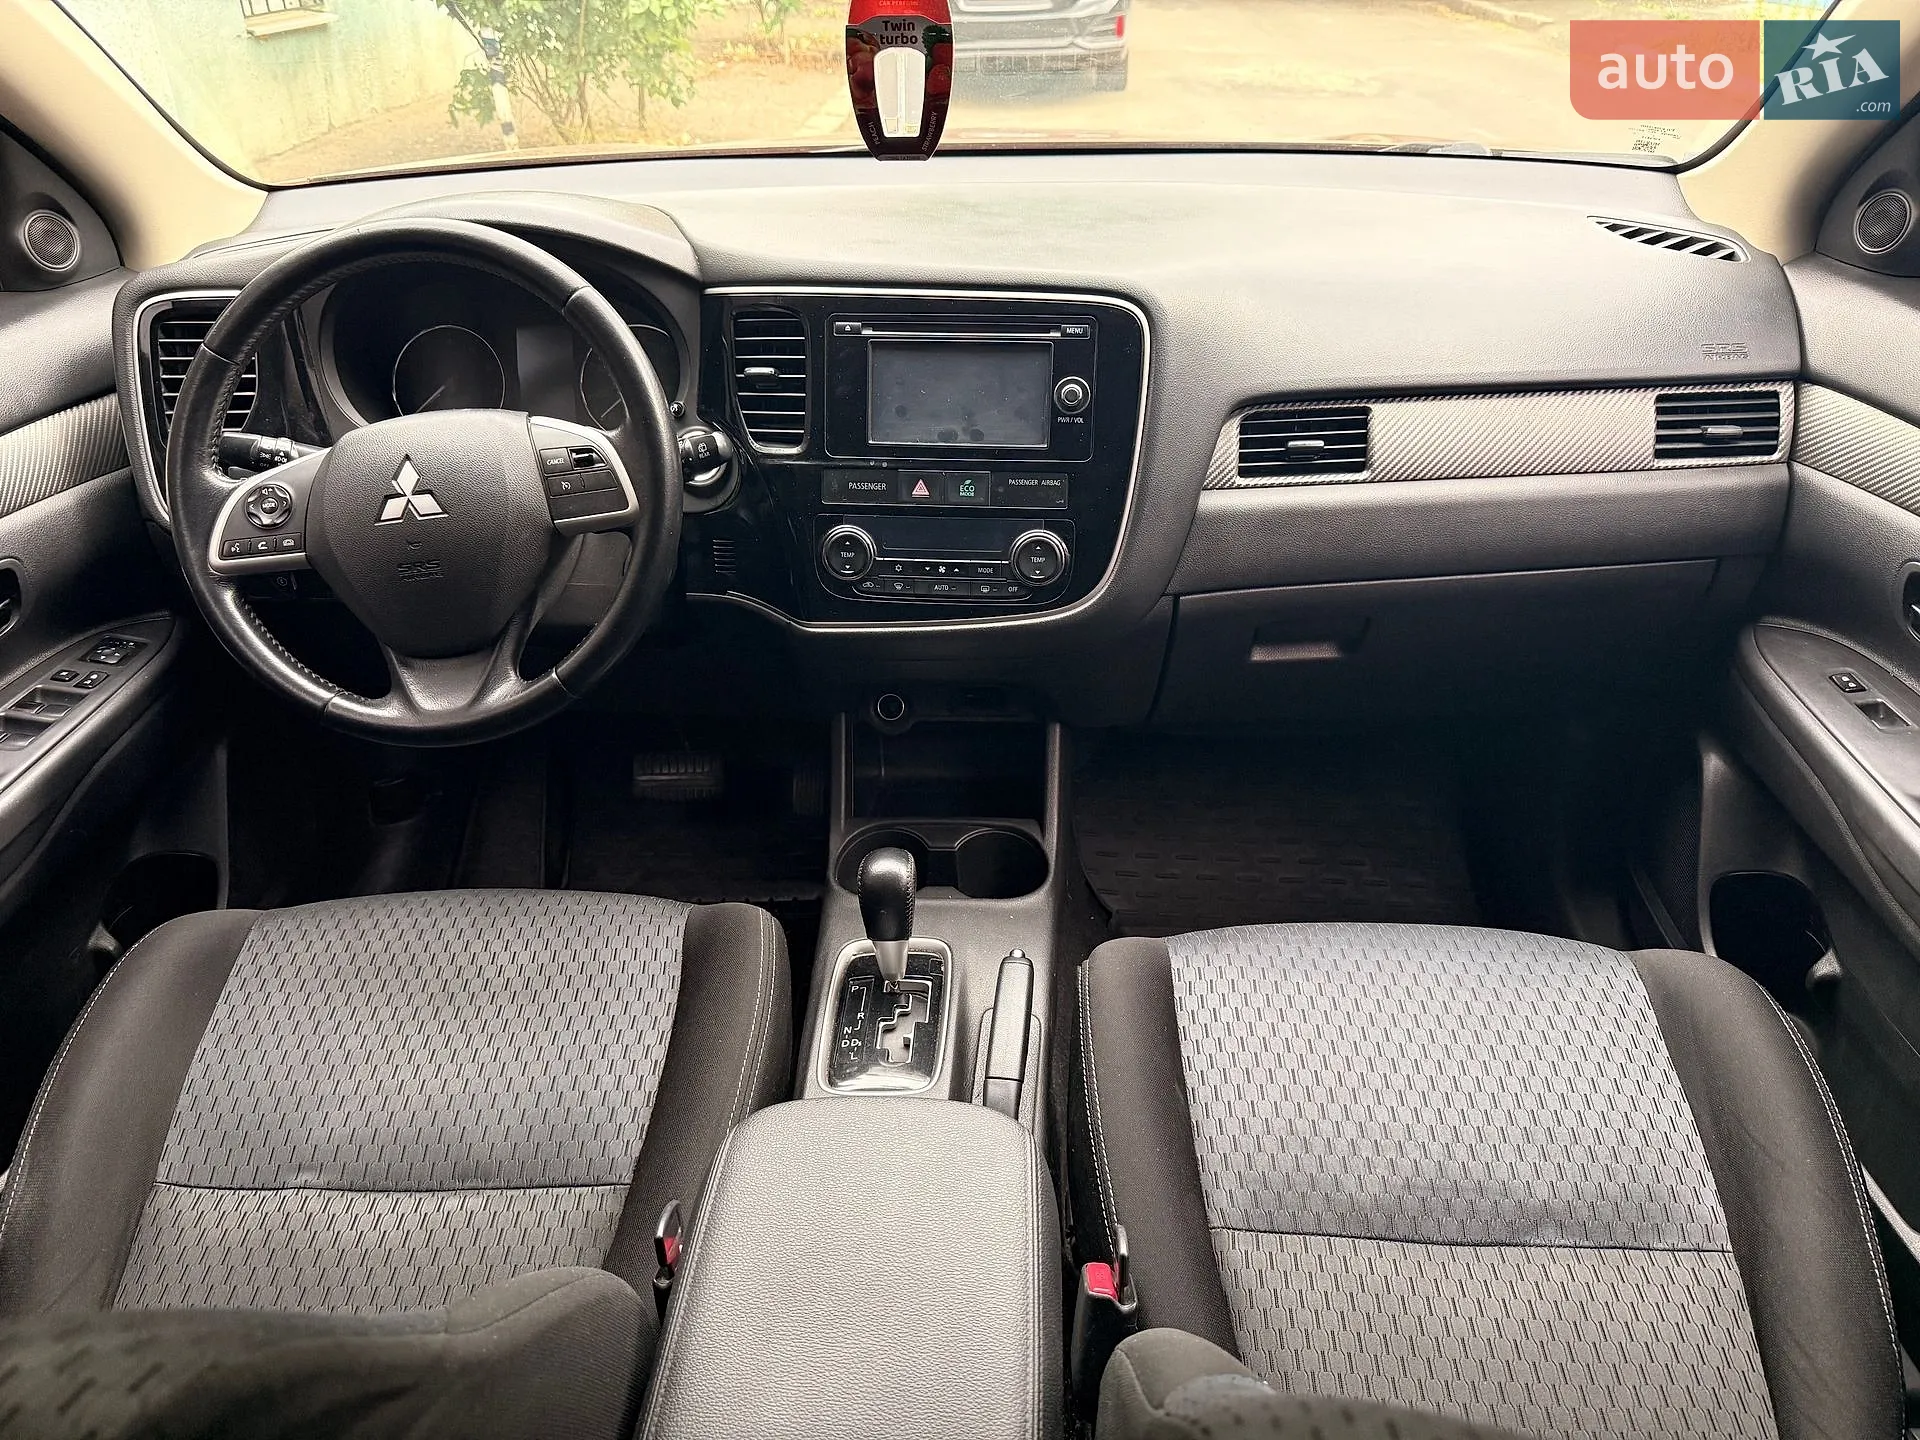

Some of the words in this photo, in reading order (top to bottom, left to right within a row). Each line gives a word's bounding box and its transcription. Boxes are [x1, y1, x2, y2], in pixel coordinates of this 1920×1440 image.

[882, 19, 916, 31] Twin
[880, 33, 918, 45] turbo
[868, 121, 881, 145] PEACH
[921, 111, 937, 151] STRAWBERRY
[546, 457, 565, 466] CANCEL
[848, 482, 887, 491] PASSENGER
[843, 1026, 852, 1034] N
[841, 1039, 850, 1047] D
